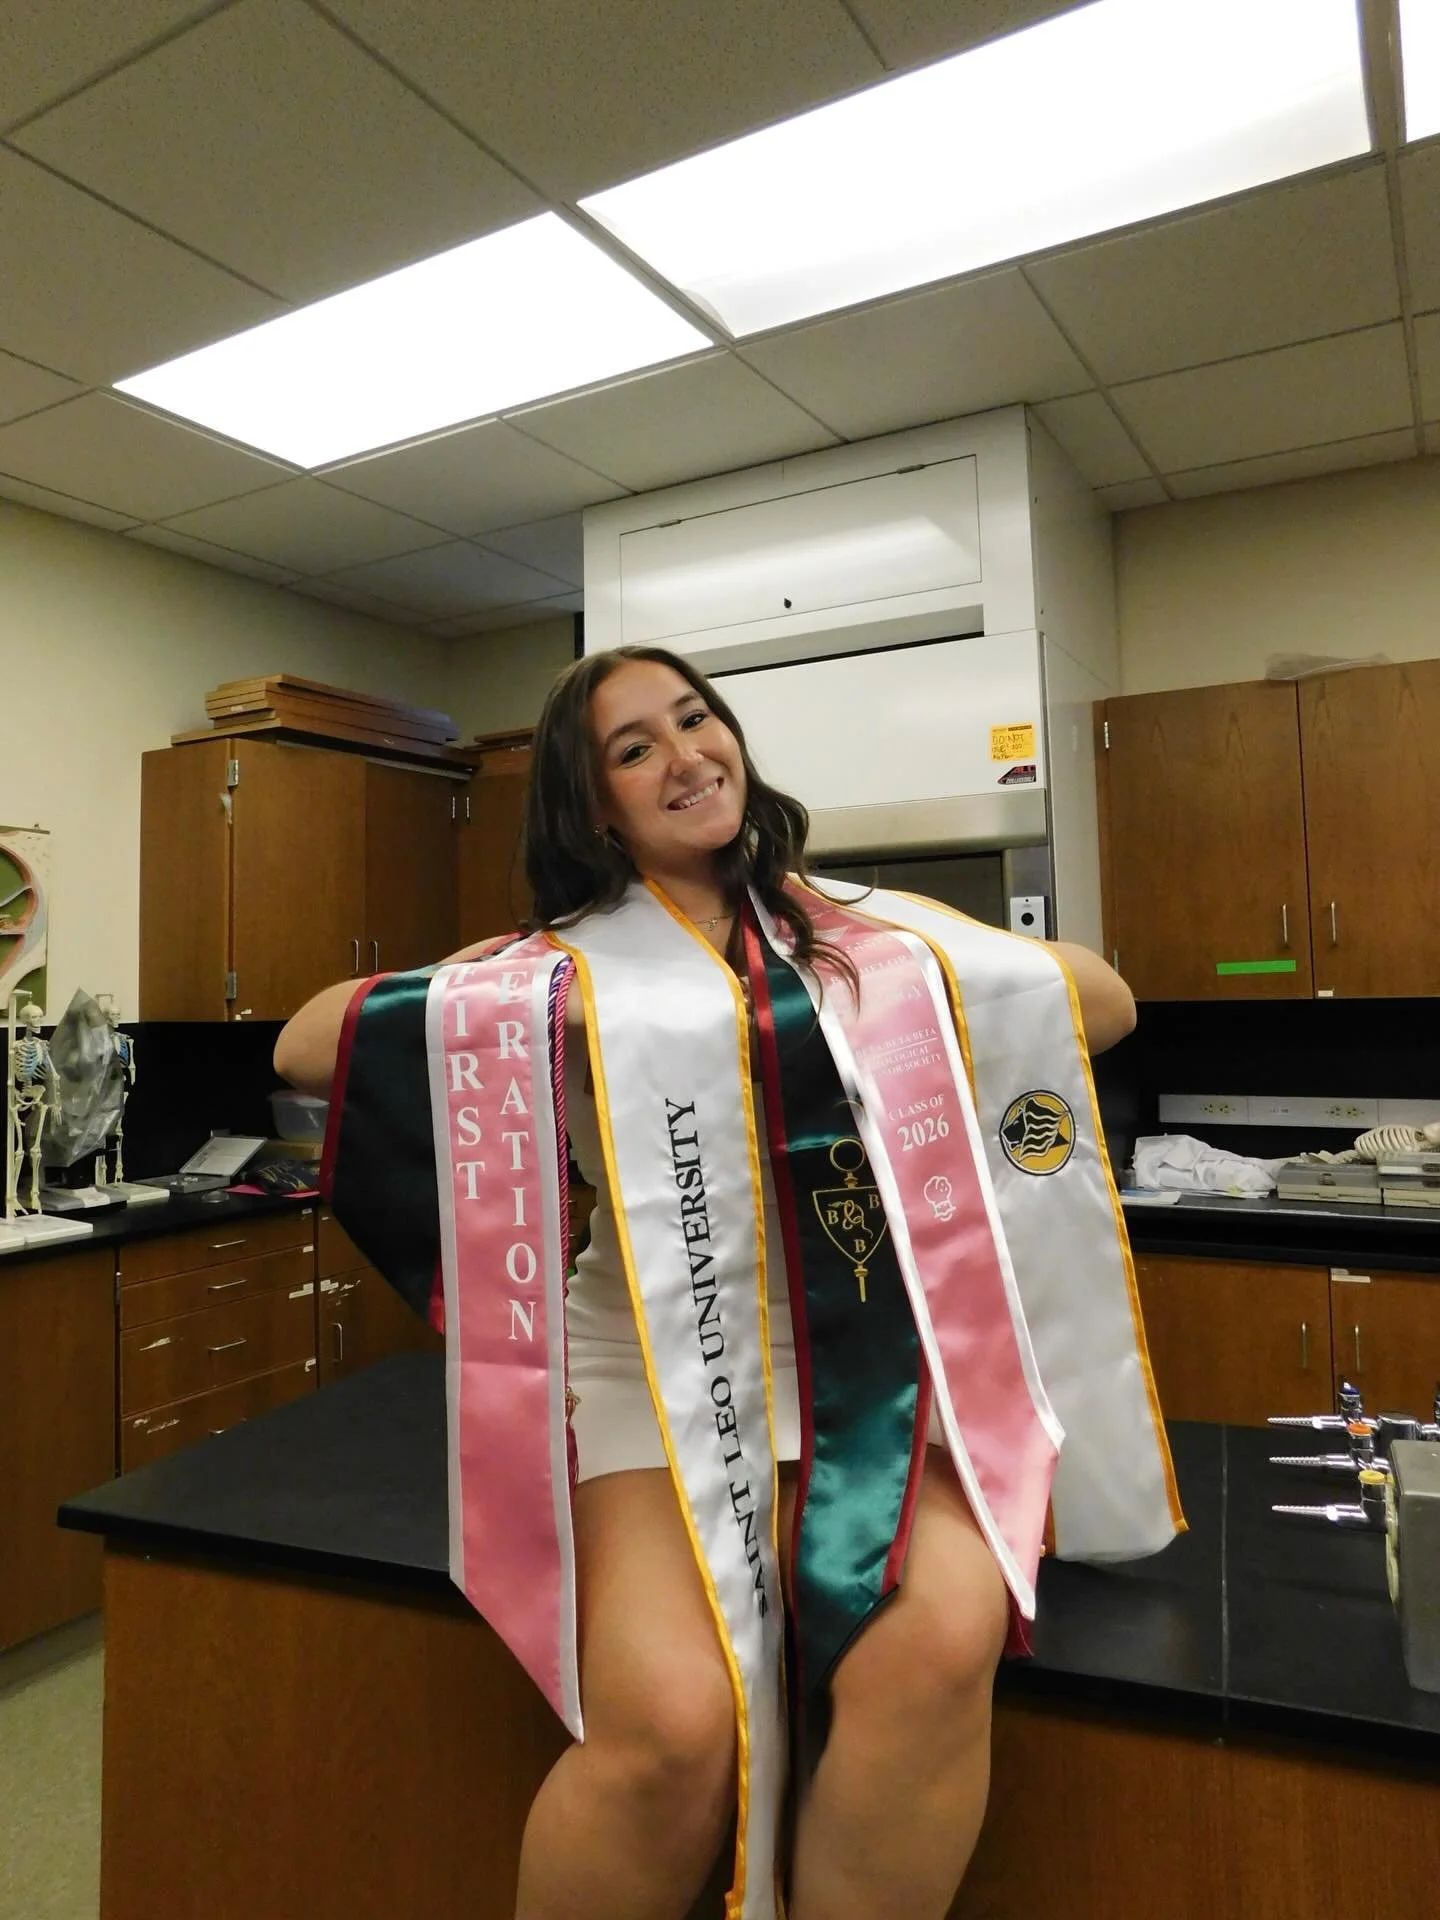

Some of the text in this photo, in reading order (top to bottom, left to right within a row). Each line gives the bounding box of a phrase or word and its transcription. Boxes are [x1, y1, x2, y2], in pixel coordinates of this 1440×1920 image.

[911, 1026, 937, 1041] BETA
[449, 964, 486, 1201] FIRST
[889, 1093, 945, 1121] CLASS OF
[896, 1112, 950, 1152] 2026
[868, 1193, 881, 1209] B
[826, 1209, 839, 1225] B
[665, 1097, 725, 1367] UNIVERSITY
[853, 1238, 867, 1253] B
[710, 1375, 744, 1468] LEO
